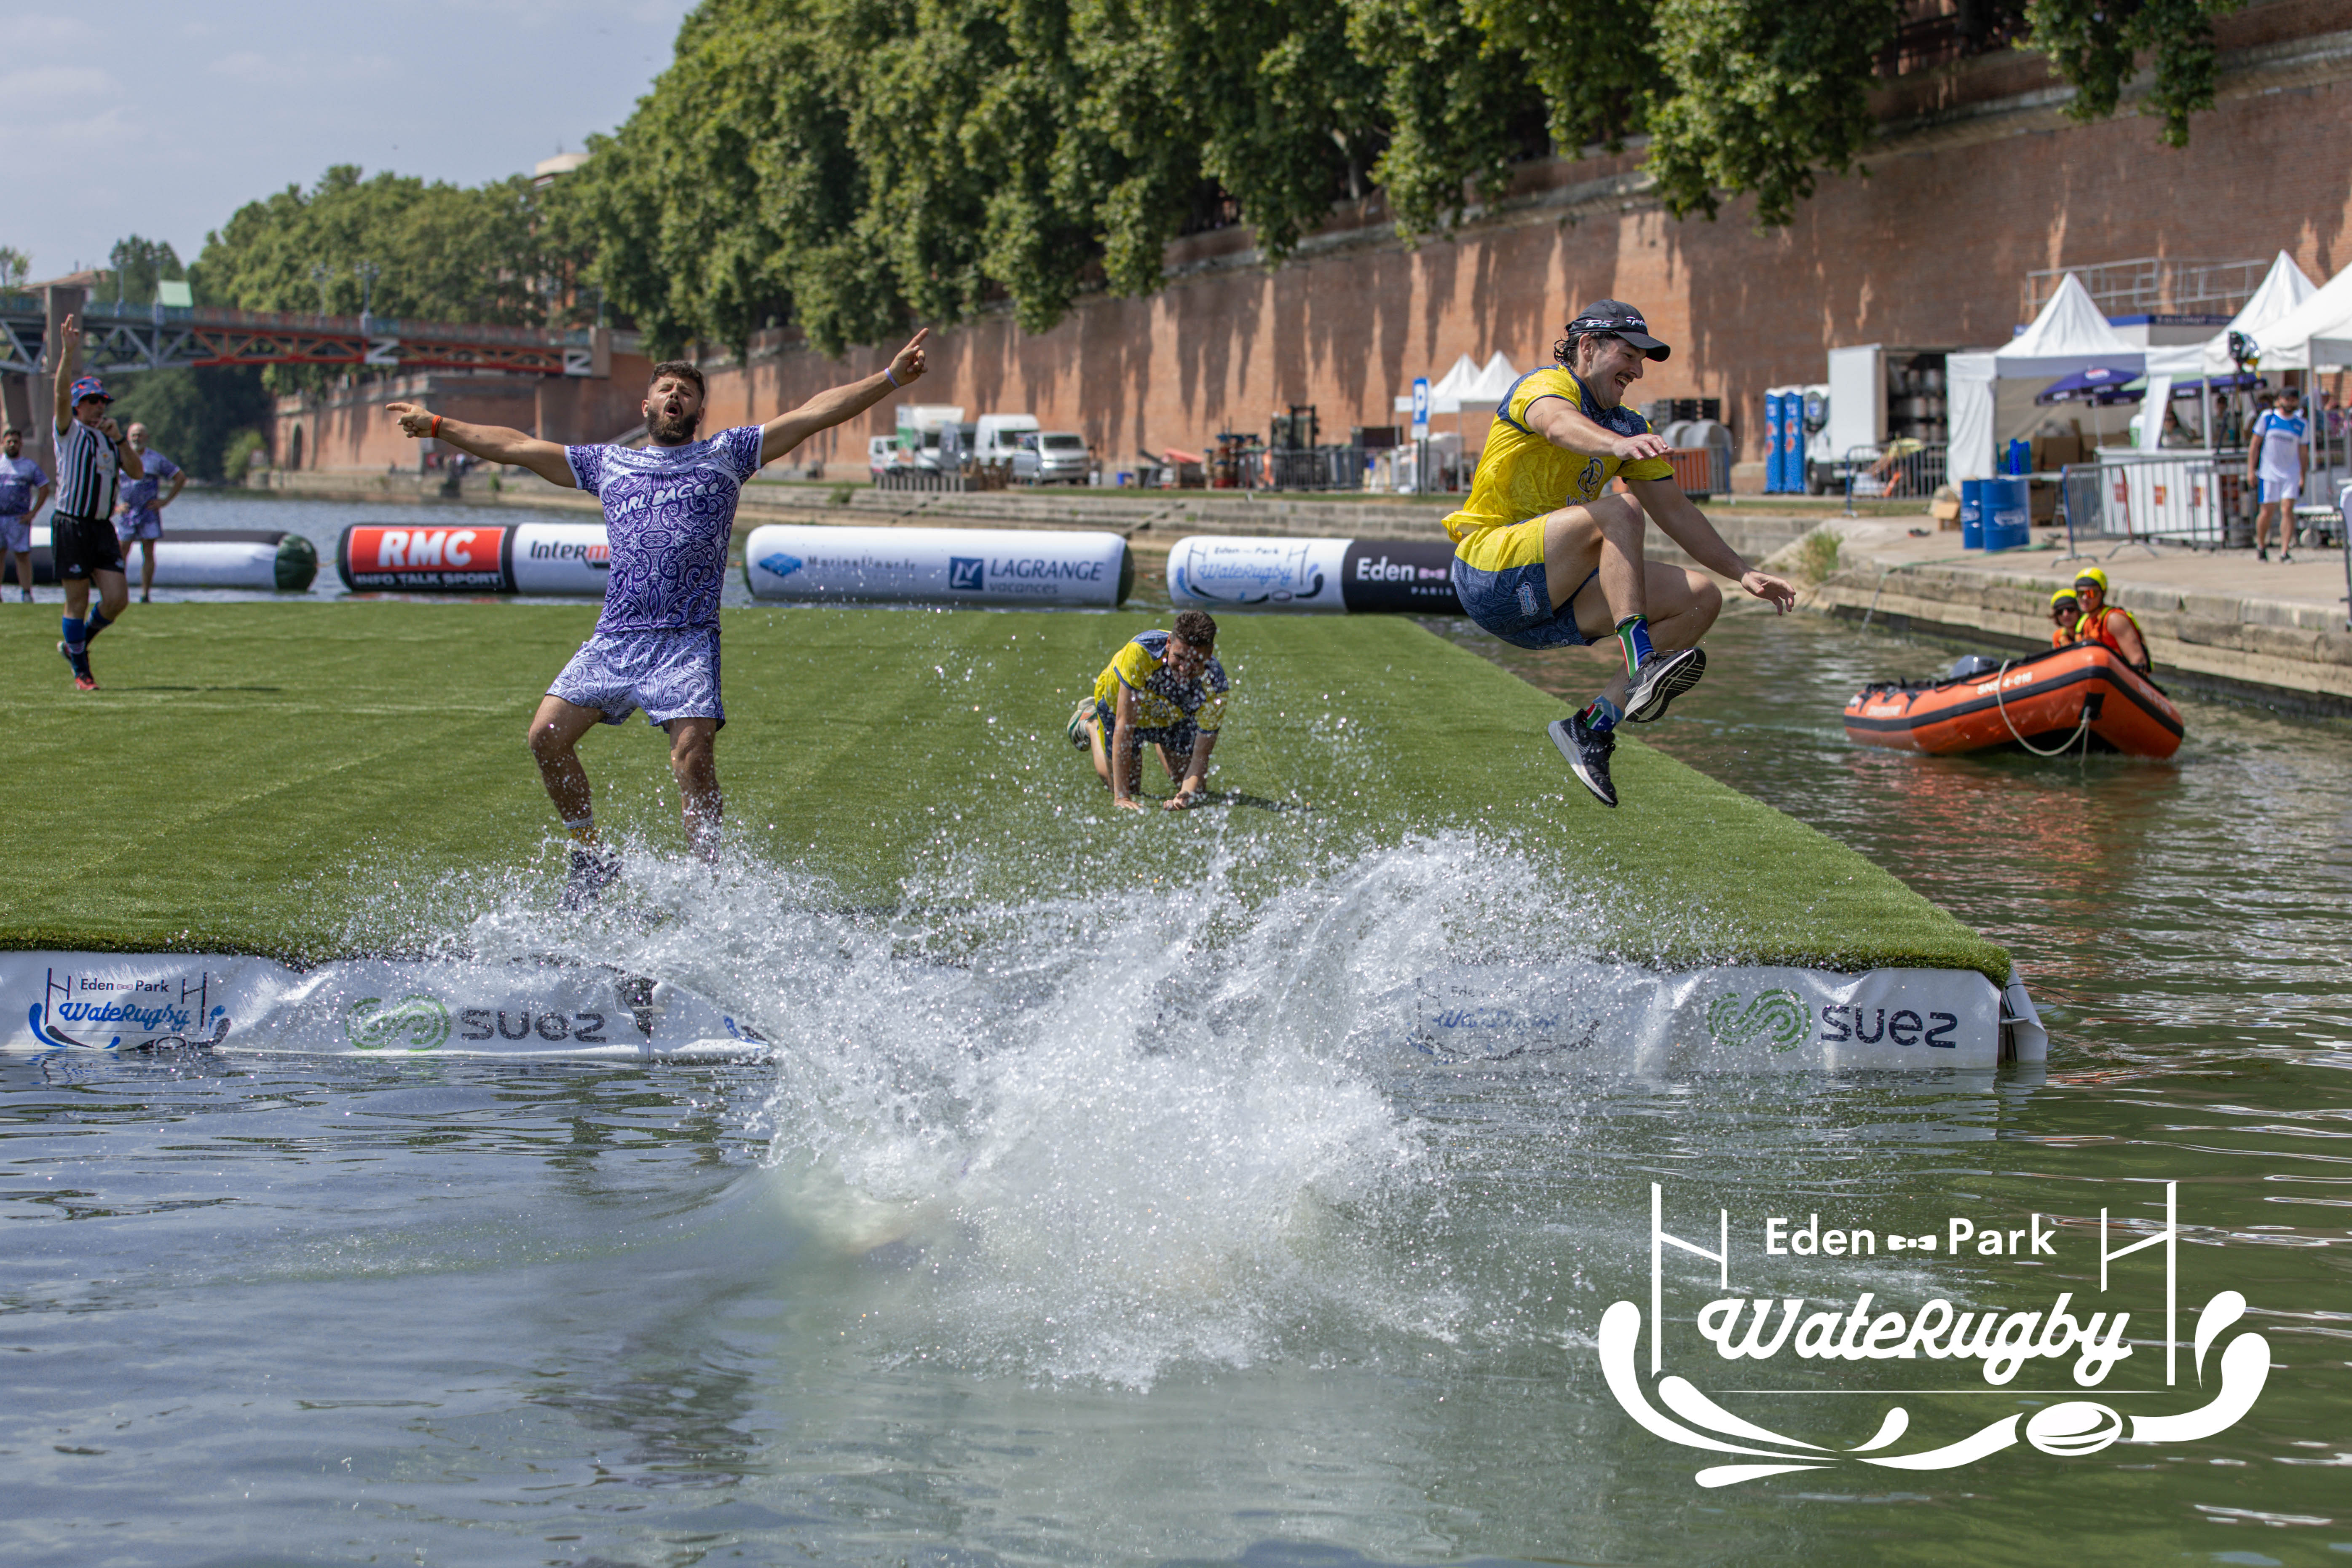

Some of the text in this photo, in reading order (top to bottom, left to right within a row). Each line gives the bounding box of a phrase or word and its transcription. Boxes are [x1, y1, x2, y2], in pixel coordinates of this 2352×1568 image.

[1586, 319, 1613, 327] TP5
[1414, 384, 1426, 421] P
[614, 494, 647, 522] SARL
[378, 531, 477, 567] RMC
[355, 572, 499, 586] INFO TALK SPORT
[990, 558, 1104, 581] LAGRANGE
[1356, 555, 1415, 582] Eden
[989, 582, 1060, 594] vacances
[1411, 586, 1453, 596] PARIS
[80, 978, 169, 992] Eden Park
[59, 1001, 191, 1032] WateRugby
[461, 1010, 607, 1043] suez
[1821, 1005, 1958, 1048] suez
